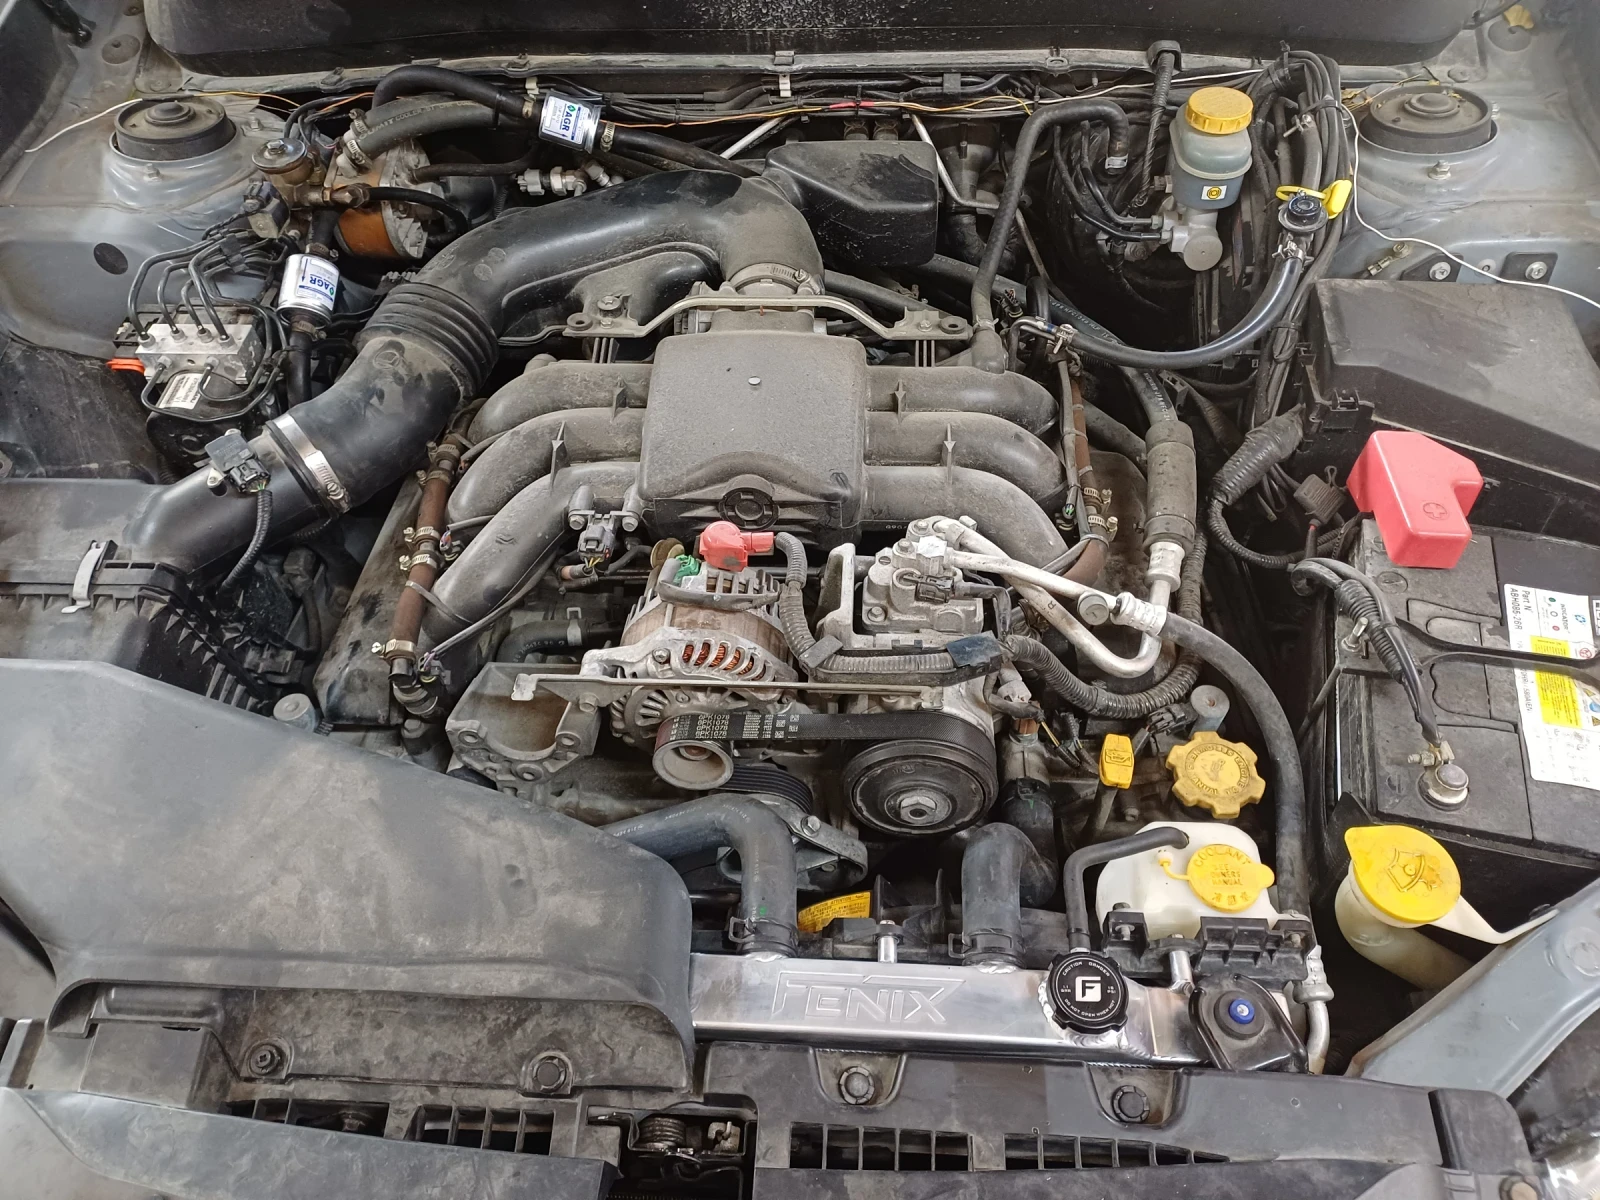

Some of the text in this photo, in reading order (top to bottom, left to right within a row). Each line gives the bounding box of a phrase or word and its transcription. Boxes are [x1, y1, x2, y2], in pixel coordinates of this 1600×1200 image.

[562, 111, 572, 131] AGR
[310, 276, 330, 290] AGR
[1522, 590, 1531, 603] Part
[1193, 847, 1252, 868] COOLANT
[1212, 878, 1243, 886] MANUAL
[1062, 961, 1110, 977] CAUTION DANGER
[771, 971, 966, 1024] FENIX
[1064, 998, 1071, 1006] DO
[1070, 1005, 1080, 1014] NOT
[1096, 1008, 1109, 1016] WHEN
